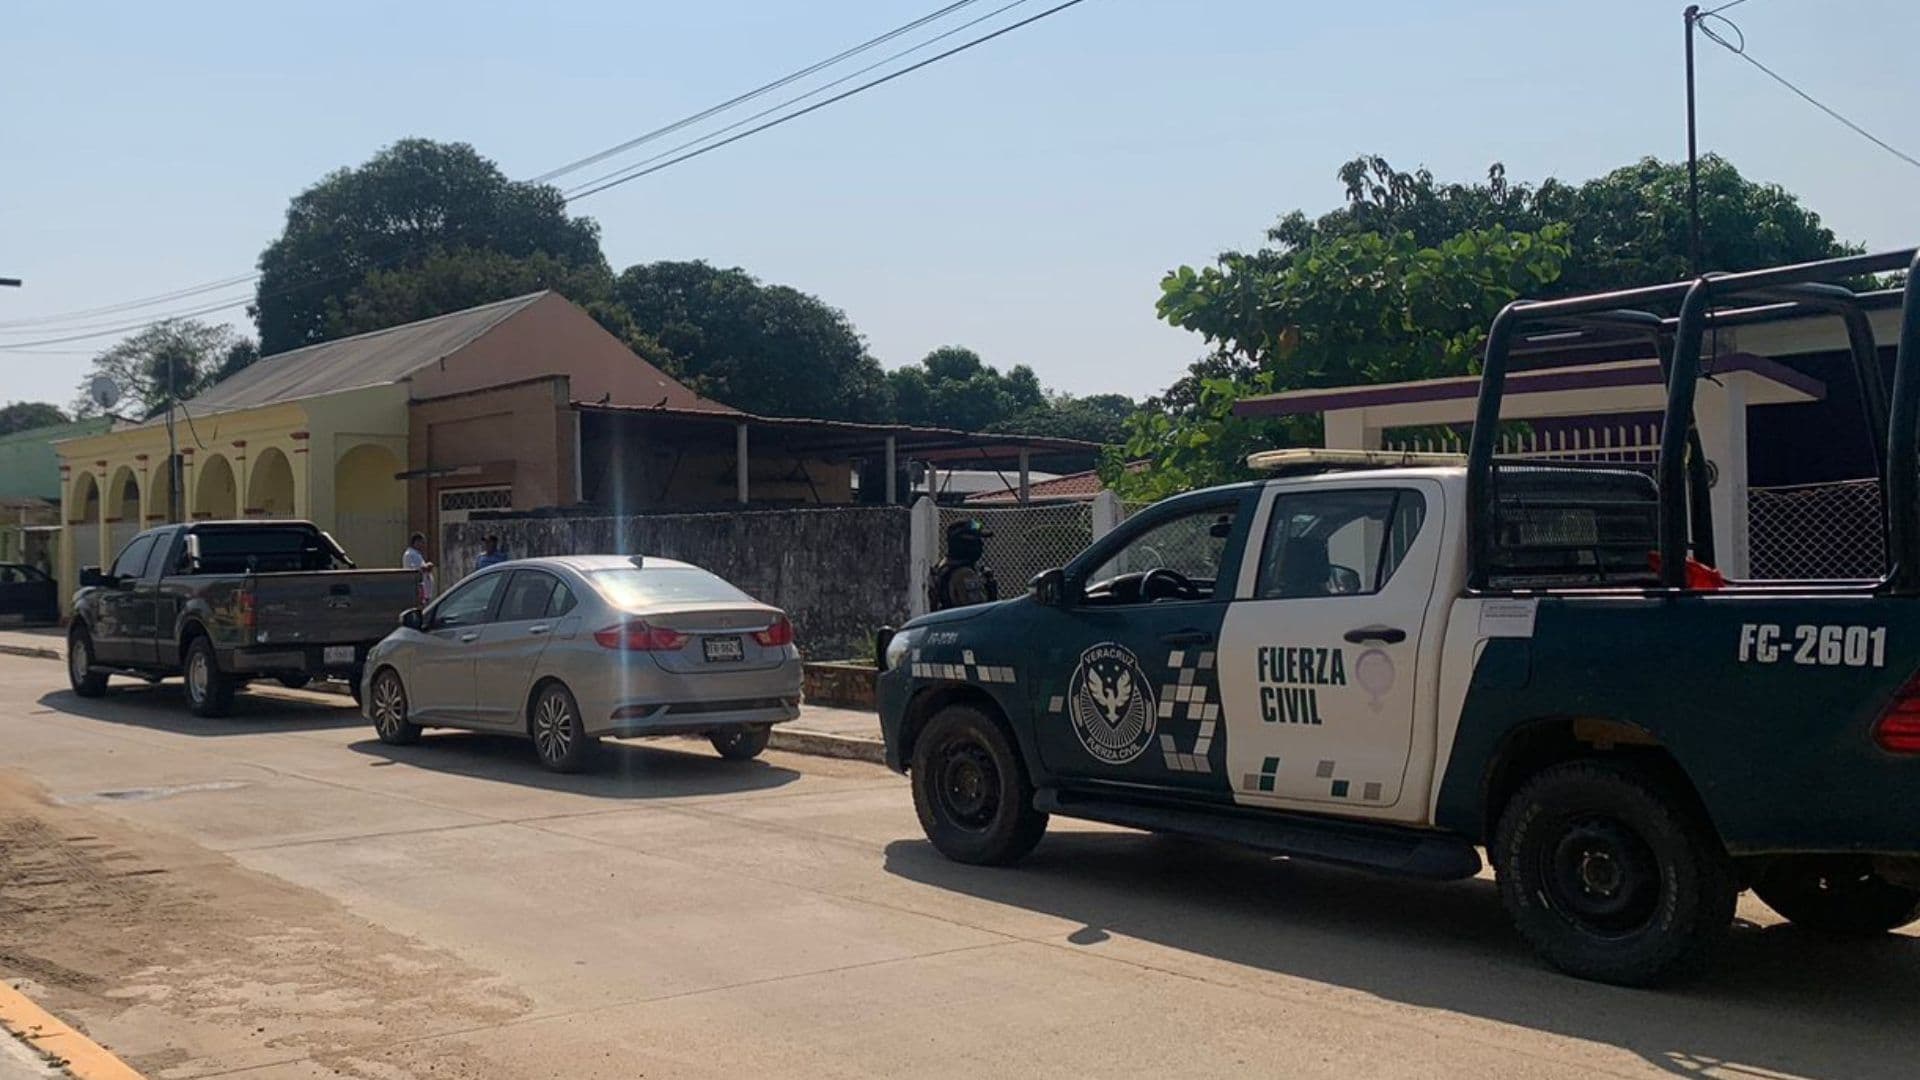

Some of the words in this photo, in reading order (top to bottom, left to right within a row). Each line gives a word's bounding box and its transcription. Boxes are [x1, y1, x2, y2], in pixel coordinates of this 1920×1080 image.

[1085, 648, 1135, 668] VERACRUZ
[1738, 623, 1886, 668] FC-2601
[1258, 646, 1346, 685] FUERZA
[1260, 686, 1322, 725] CIVIL
[1086, 736, 1119, 760] FUERZA
[1119, 743, 1141, 759] CIVIL
